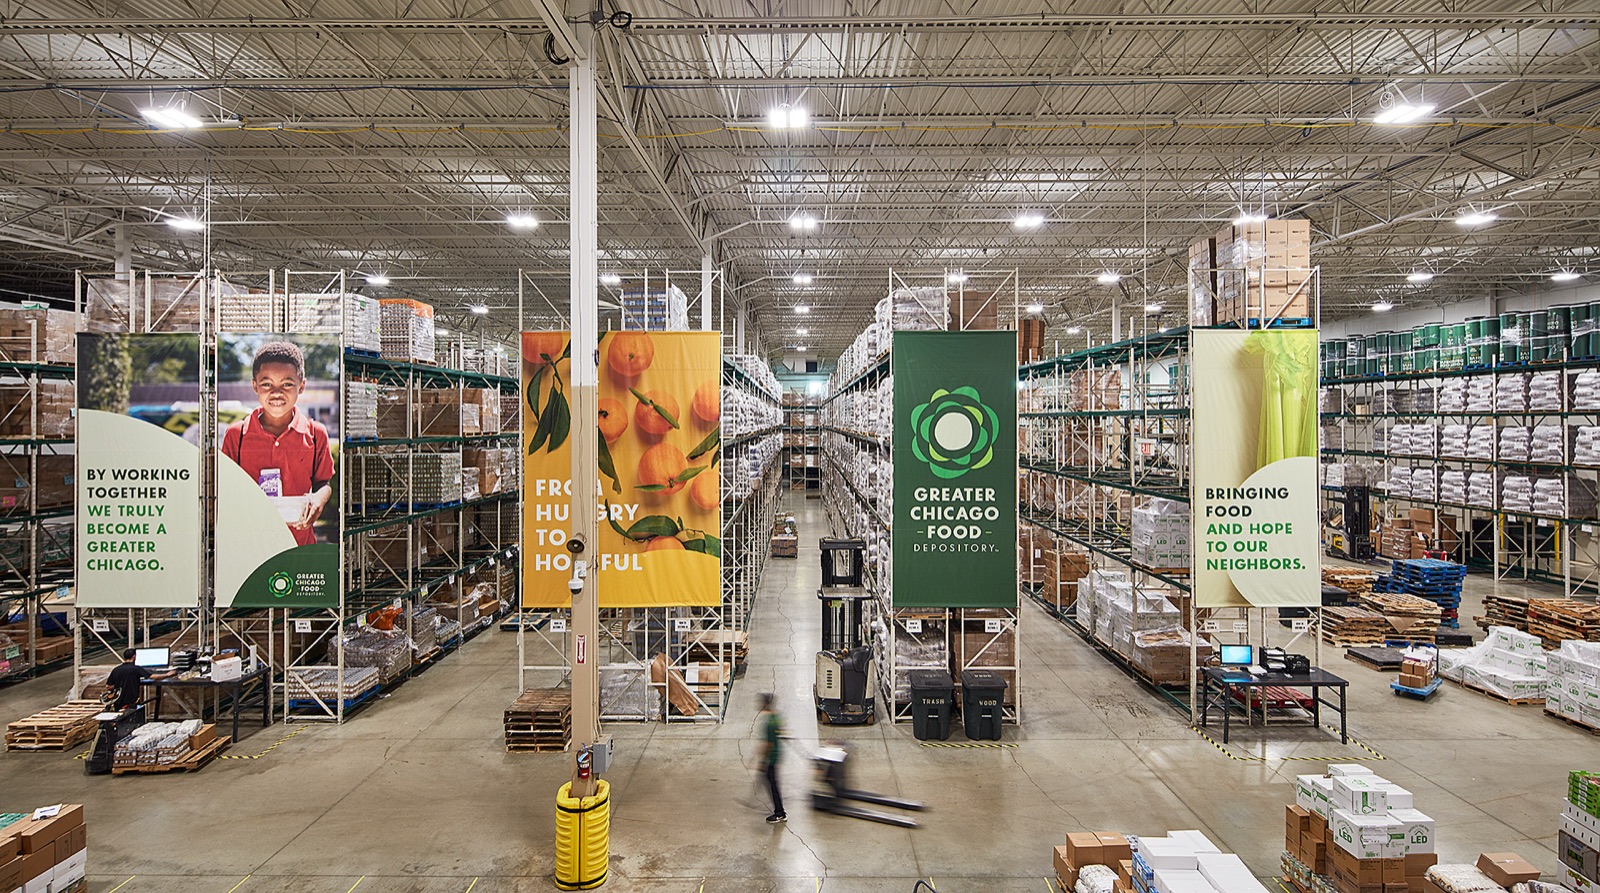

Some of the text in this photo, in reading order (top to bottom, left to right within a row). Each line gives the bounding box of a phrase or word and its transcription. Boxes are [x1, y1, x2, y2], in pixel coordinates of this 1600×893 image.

[88, 469, 190, 480] BY WORKING
[87, 487, 166, 498] TOGETHER
[536, 479, 603, 496] FR
[914, 488, 995, 501] GREATER
[1206, 488, 1289, 499] BRINGING
[88, 505, 164, 516] WE TRULY
[536, 504, 639, 521] HUGRY
[910, 506, 999, 520] CHICAGO
[1206, 506, 1252, 517] FOOD
[87, 524, 166, 534] BECOME A
[1207, 523, 1292, 534] AND HOPE
[536, 529, 566, 546] TO
[87, 541, 155, 552] GREATER
[1206, 541, 1267, 552] TO OUR
[87, 559, 164, 570] CHICAGO.
[536, 554, 642, 571] HOFUL
[1207, 558, 1305, 570] NEIGHBORS.
[1339, 828, 1352, 843] LED
[1411, 836, 1427, 844] LED
